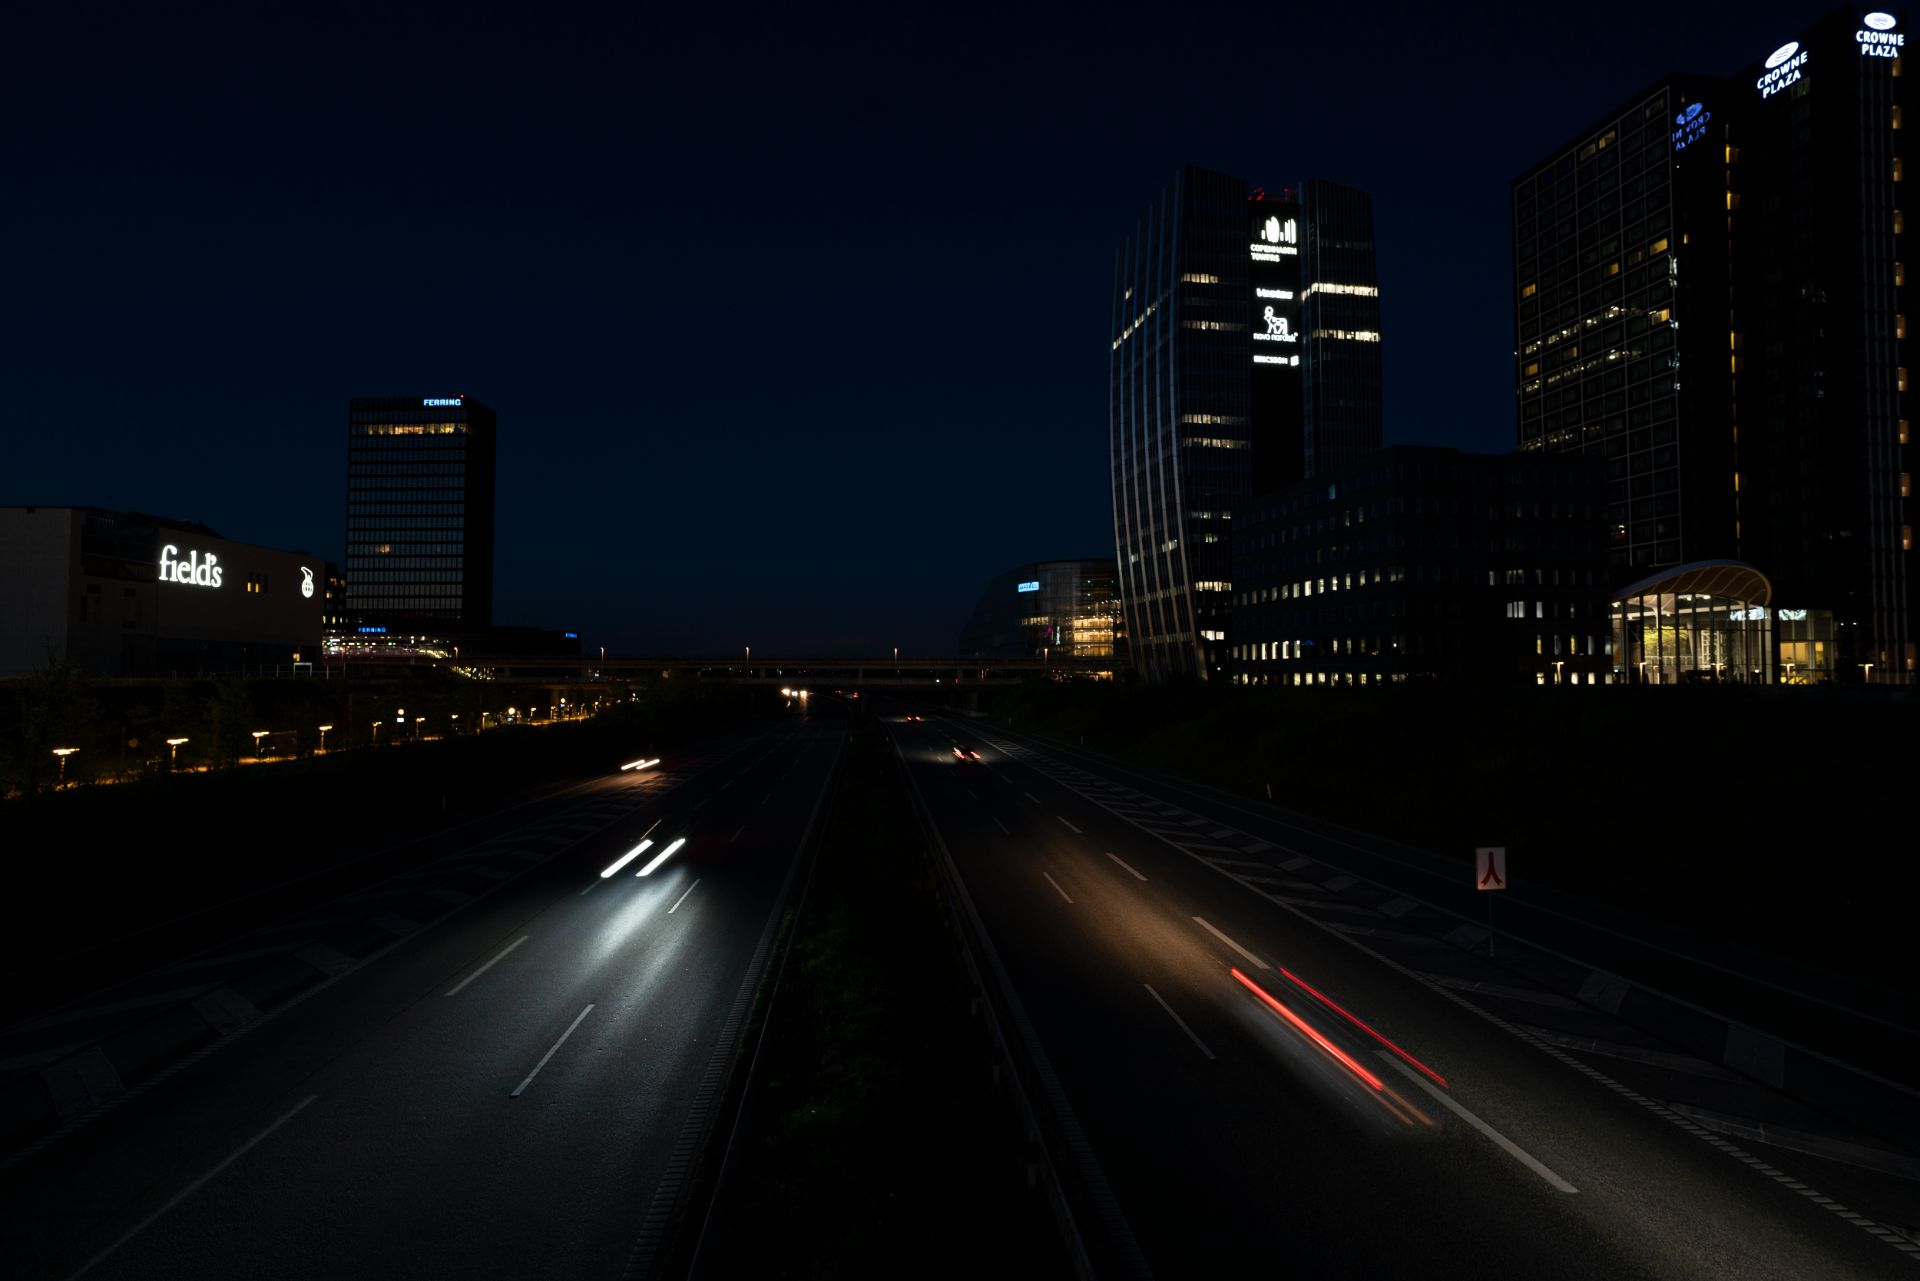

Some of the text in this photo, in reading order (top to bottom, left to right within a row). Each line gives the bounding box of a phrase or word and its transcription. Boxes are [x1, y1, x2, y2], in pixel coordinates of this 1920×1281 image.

[1856, 30, 1905, 47] CROWNE
[1862, 44, 1899, 59] PLAZA
[1757, 51, 1808, 89] CROWNE
[1763, 69, 1801, 99] PLAZA
[1250, 244, 1297, 255] COPENHAGEN
[1251, 252, 1280, 262] TOWERS
[1253, 333, 1296, 342] novo nordisk
[1254, 355, 1288, 364] ERICSSON
[423, 398, 462, 407] FERRING
[159, 544, 222, 588] field's
